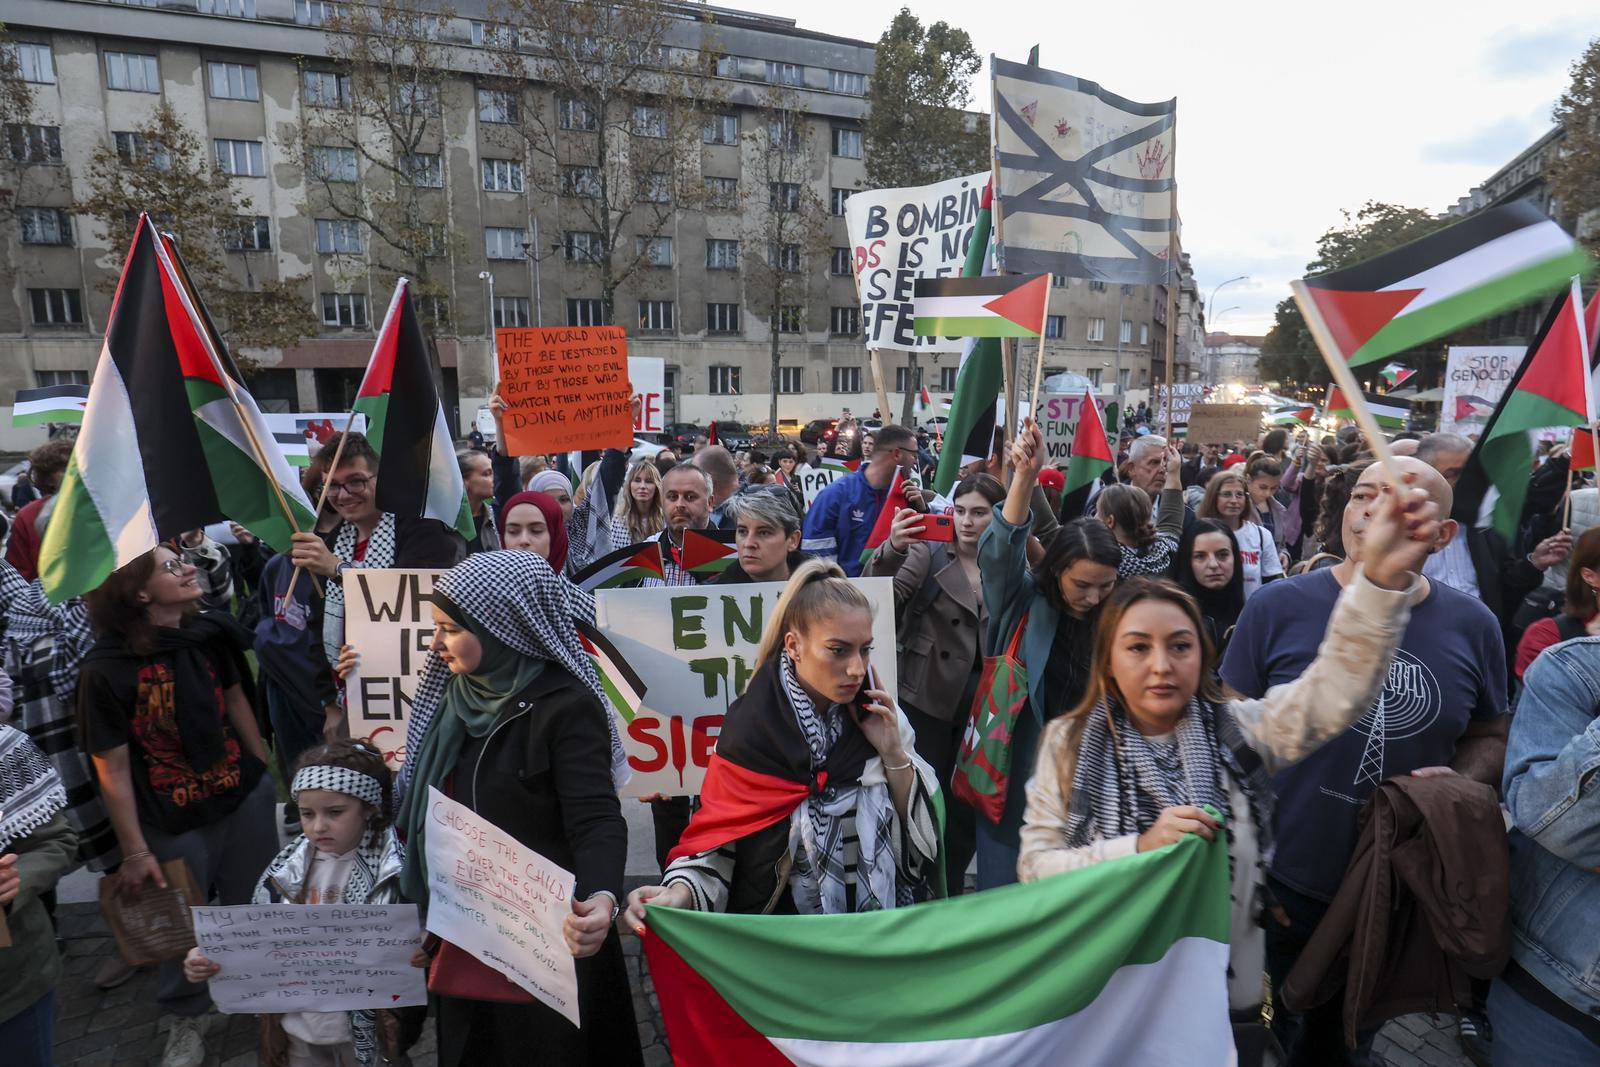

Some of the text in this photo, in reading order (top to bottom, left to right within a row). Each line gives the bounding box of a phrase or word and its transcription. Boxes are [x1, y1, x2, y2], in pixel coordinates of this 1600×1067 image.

[899, 237, 929, 268] IS
[499, 329, 626, 348] THE WORLD WILL
[502, 346, 618, 366] NOT BE DESTROYED
[1469, 356, 1508, 369] STOP
[505, 363, 623, 380] BY THOSE WHO DO EVIL
[1451, 369, 1514, 381] GENOCID
[508, 374, 618, 394] BUT BY THOSE WHO
[507, 391, 630, 409] WATCH THEM WITHOUT
[510, 402, 630, 429] DOING ANYTHING
[432, 801, 565, 901] CHOOSE THE CHILD
[467, 849, 497, 875] OVER
[499, 866, 519, 885] THE
[198, 911, 234, 928] MY
[247, 911, 296, 921] NAME
[331, 909, 388, 920] ALEYNA
[200, 933, 224, 941] MY
[272, 926, 310, 935] MADE
[318, 925, 353, 933] THIS
[361, 925, 392, 933] SIGN
[203, 945, 234, 954] FOR
[240, 942, 260, 951] ME
[271, 938, 338, 950] BECAUSE
[345, 938, 372, 946] SHE
[267, 950, 357, 959] PALESTINIANS
[281, 959, 354, 967] CHILDREN
[312, 988, 328, 996] TO
